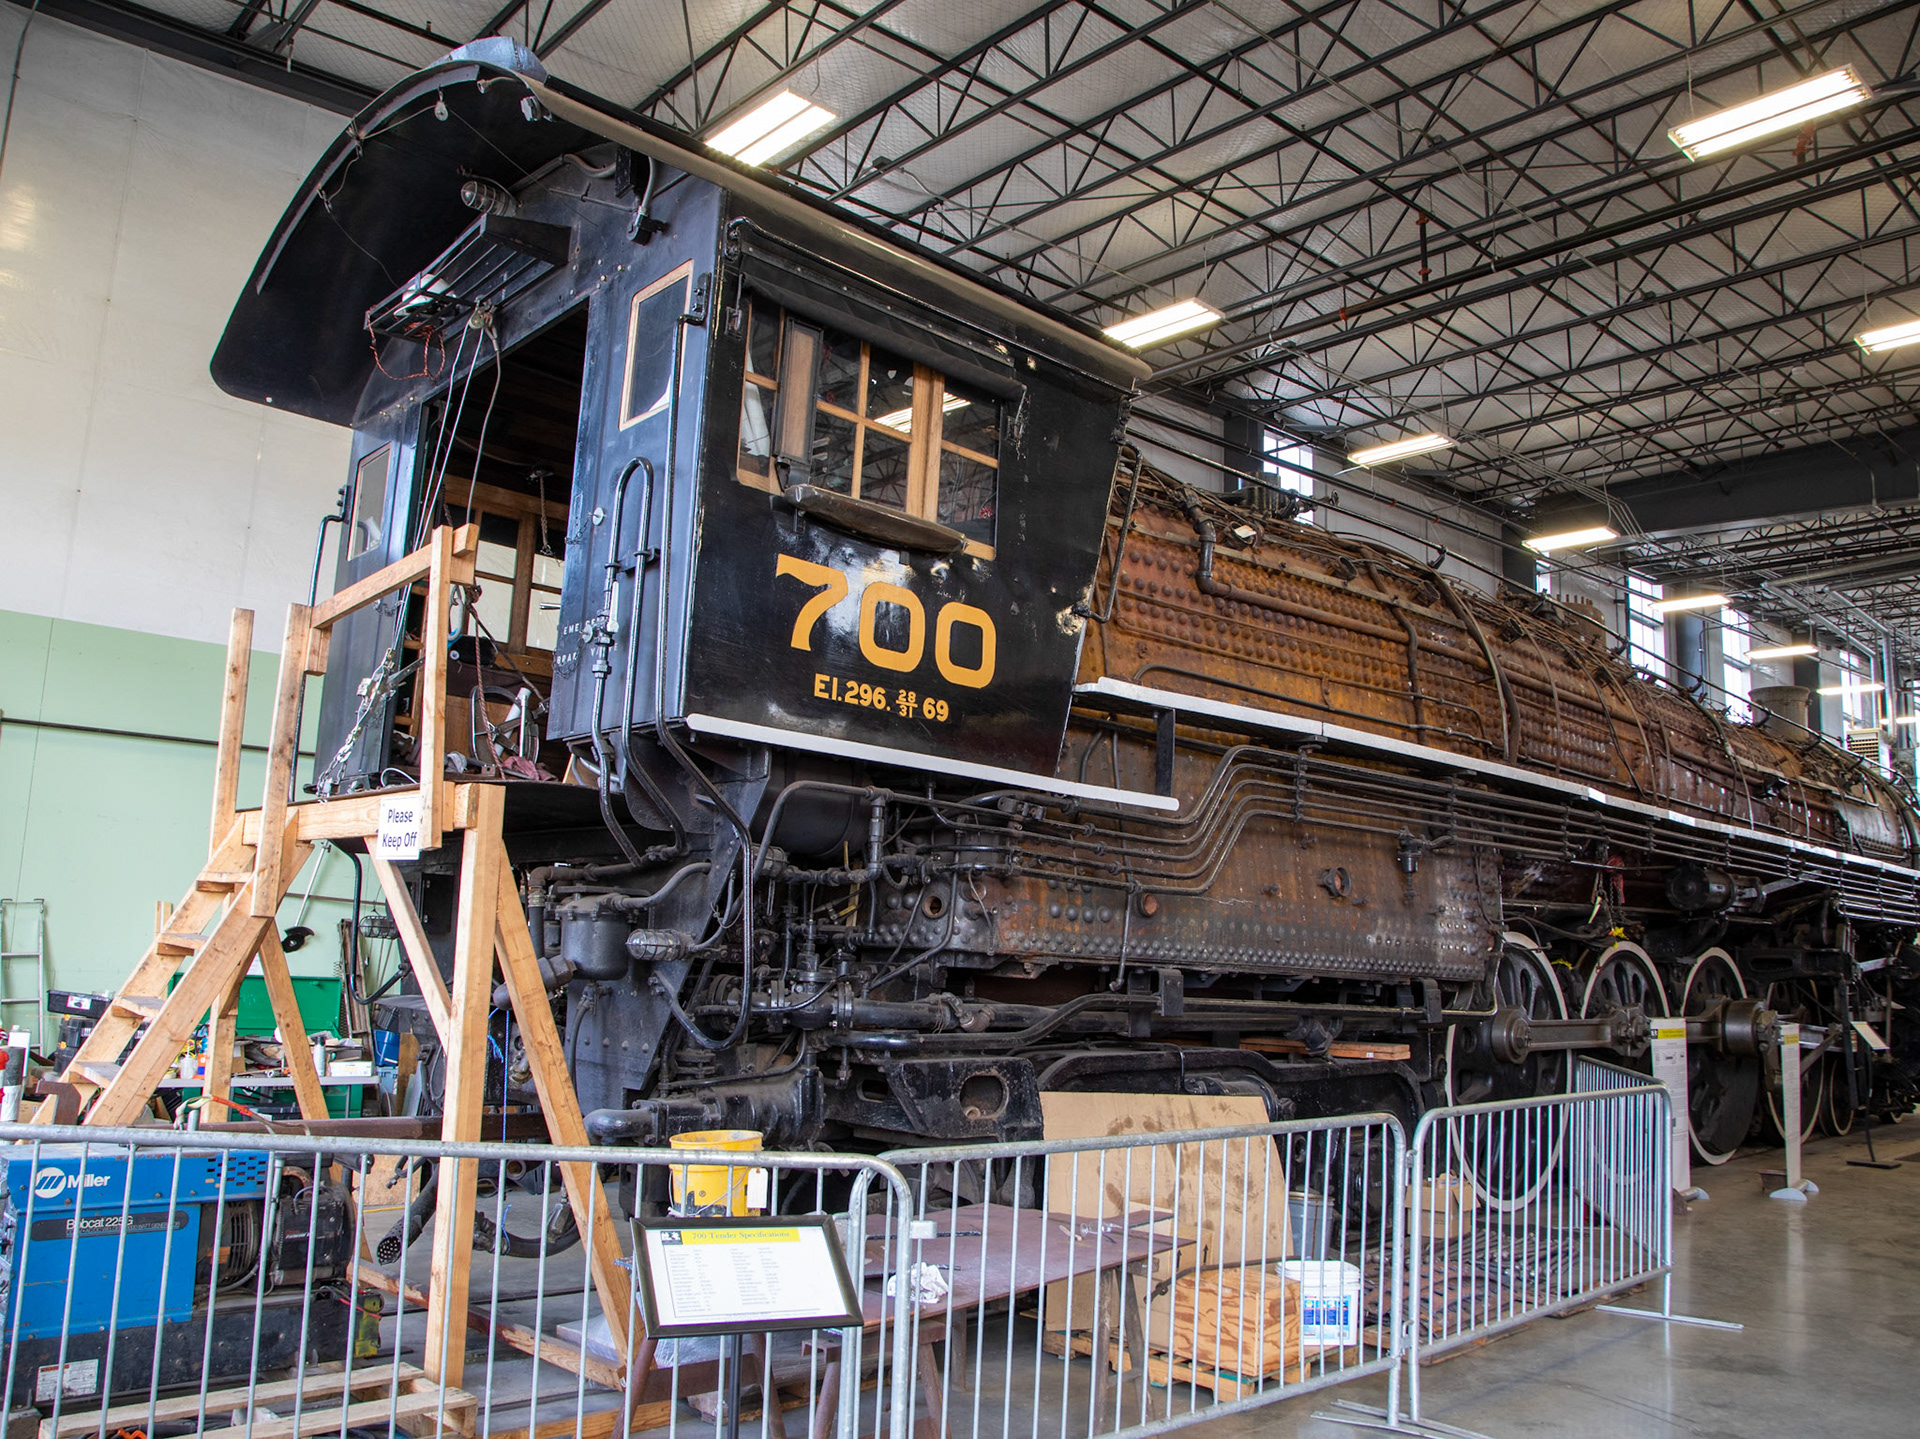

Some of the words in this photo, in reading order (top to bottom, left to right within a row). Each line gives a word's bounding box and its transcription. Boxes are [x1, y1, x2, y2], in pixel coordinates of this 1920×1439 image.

[776, 553, 997, 689] 700
[922, 697, 949, 722] 69
[387, 808, 413, 823] Please
[382, 832, 402, 851] Keep
[404, 831, 418, 847] Off
[67, 1174, 111, 1188] Miller
[66, 1217, 104, 1230] Bbcat
[739, 1231, 790, 1239] Specifications
